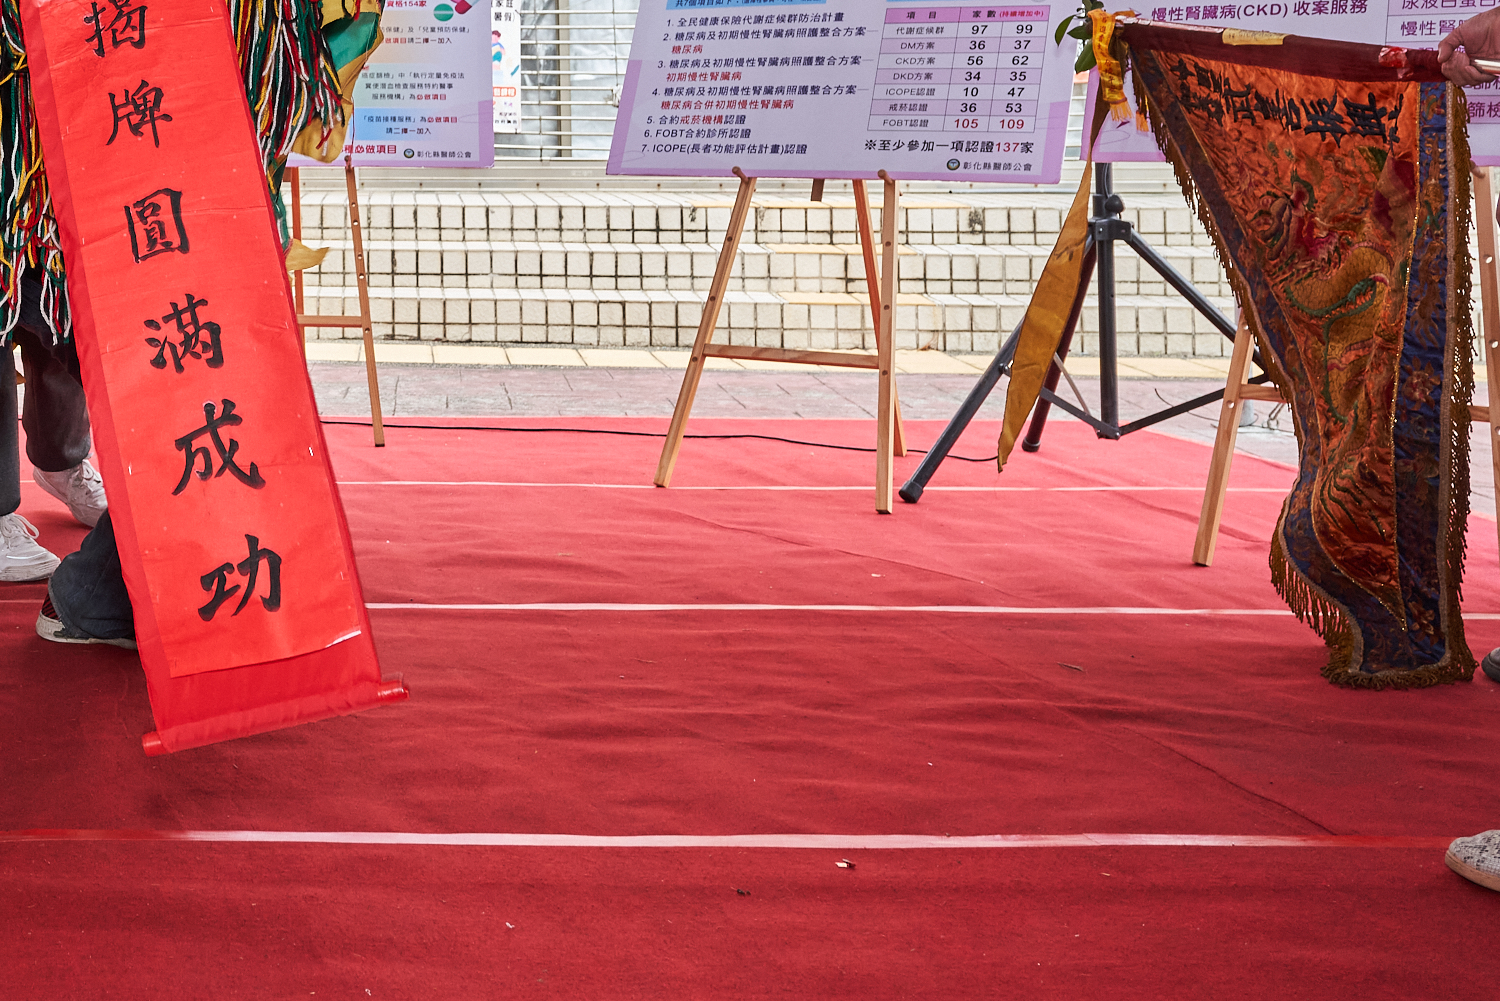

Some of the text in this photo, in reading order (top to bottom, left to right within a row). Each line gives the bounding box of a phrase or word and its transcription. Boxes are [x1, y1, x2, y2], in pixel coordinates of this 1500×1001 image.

[677, 11, 845, 28] 全民健康保險代謝症候群防治計畫
[896, 23, 1033, 36] 代謝症候群 97 99
[1400, 19, 1464, 37] 慢性腎
[671, 44, 704, 55] 糖尿病
[900, 40, 1032, 50] DM方案 36 37
[895, 55, 1029, 66] CKD方案 56 62
[666, 71, 742, 82] 初期慢性腎臟病
[892, 71, 1027, 82] DKD方案 34 35
[885, 87, 1025, 97] ICOPE認證 10 47
[660, 98, 795, 110] 糖尿病合併初期慢性腎臟病
[888, 102, 1023, 113] 戒菸認證 36 53
[658, 114, 747, 125] 合約戒菸機構認證
[882, 118, 1025, 130] FOBT認證 105 109
[962, 161, 1033, 172] 彰化縣醫師公會
